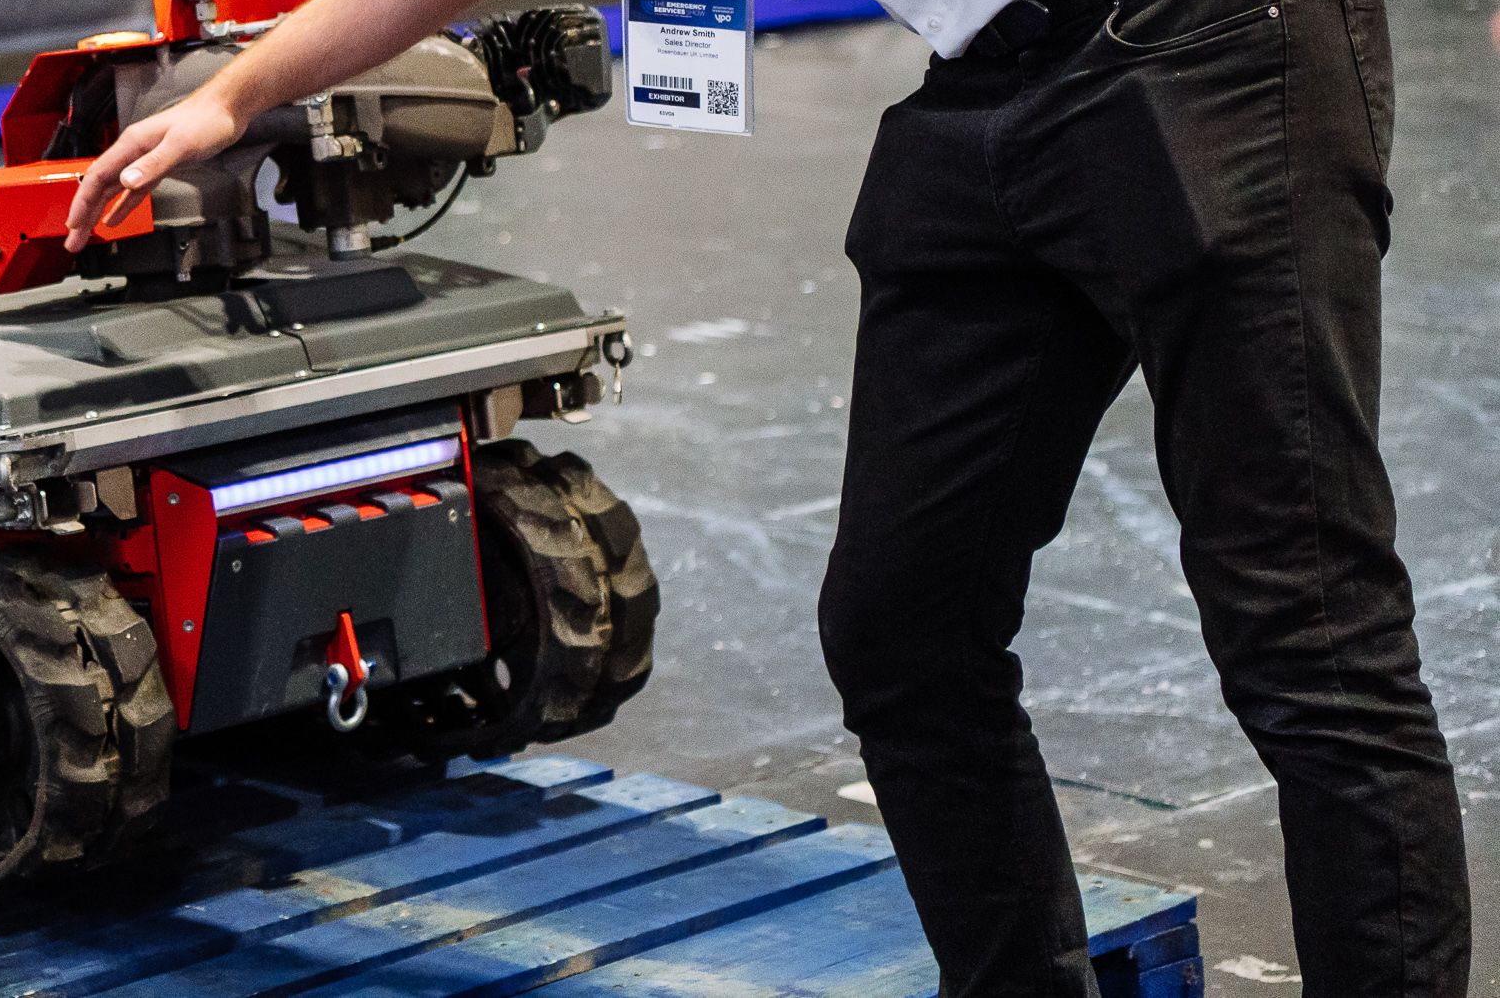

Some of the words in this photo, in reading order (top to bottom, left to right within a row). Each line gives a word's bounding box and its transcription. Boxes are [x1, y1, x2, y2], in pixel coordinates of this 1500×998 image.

[653, 6, 686, 15] SERVICES
[666, 1, 707, 11] EMERGENCY
[660, 26, 691, 36] Andrew
[692, 28, 716, 38] Smith
[664, 38, 683, 47] Sales
[685, 40, 712, 49] Director
[648, 92, 685, 103] EXHIBITOR
